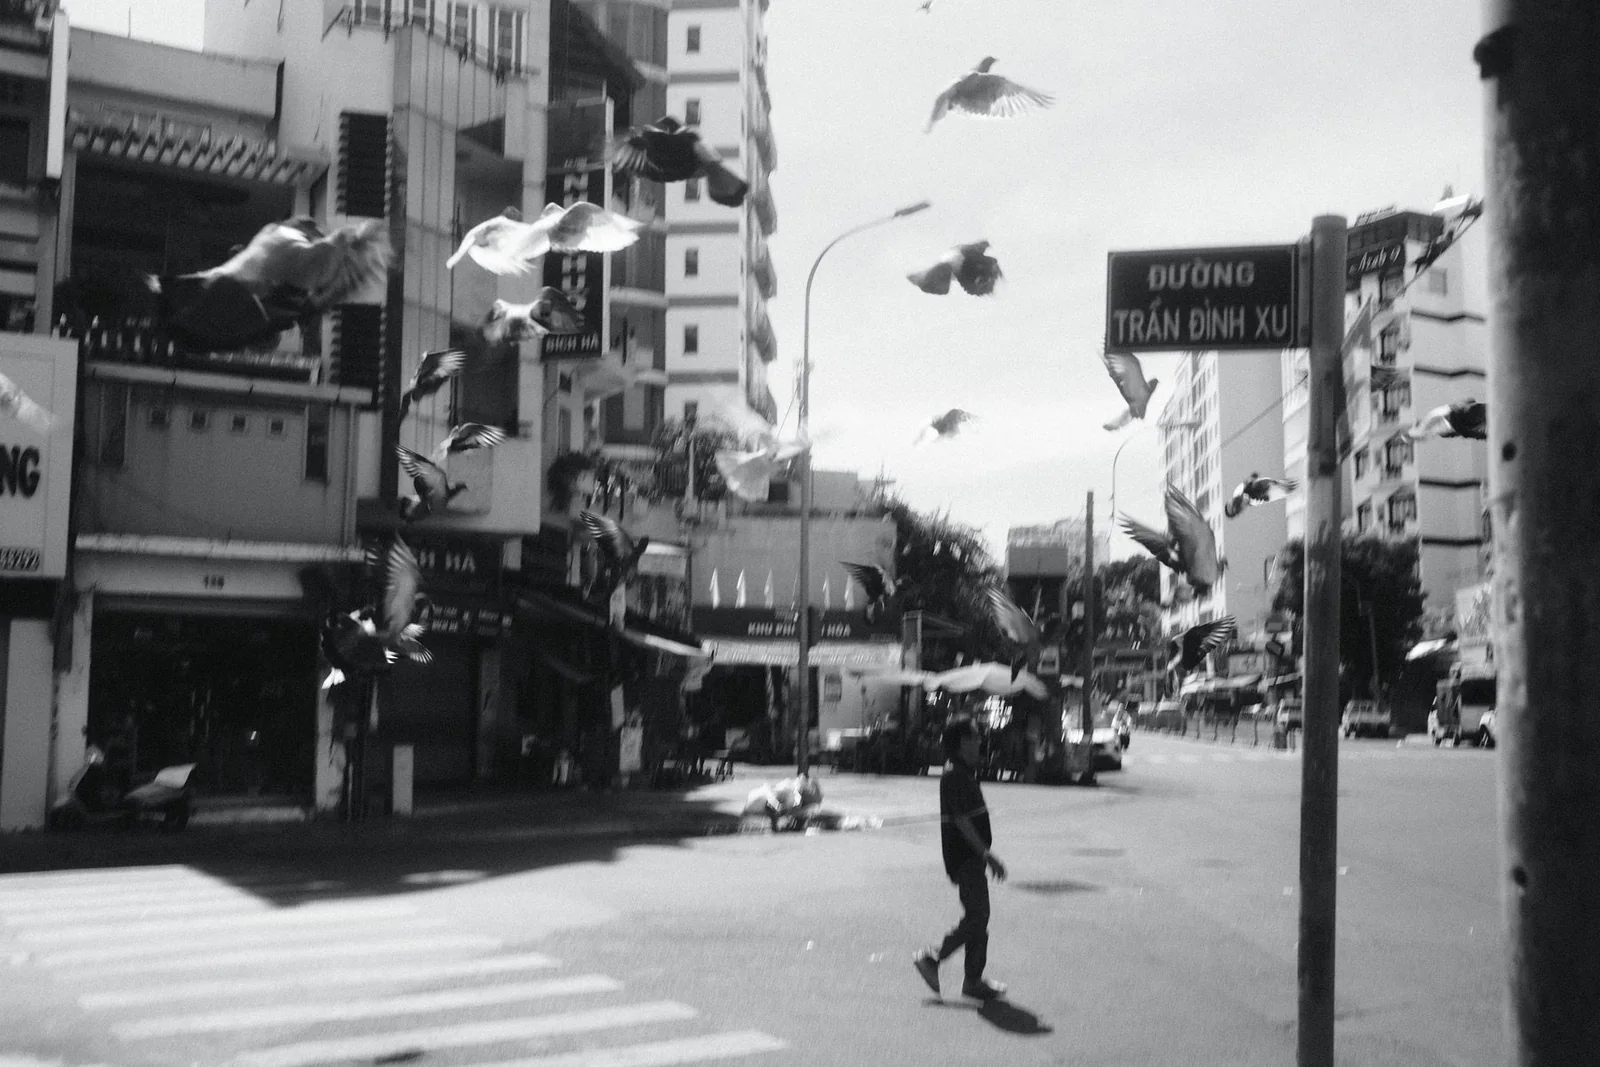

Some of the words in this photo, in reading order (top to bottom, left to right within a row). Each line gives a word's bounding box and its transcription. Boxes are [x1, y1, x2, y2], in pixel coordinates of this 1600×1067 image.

[1148, 257, 1255, 292] ĐƯỜNG
[1188, 297, 1245, 341] ĐÌNH
[1255, 304, 1288, 339] XU
